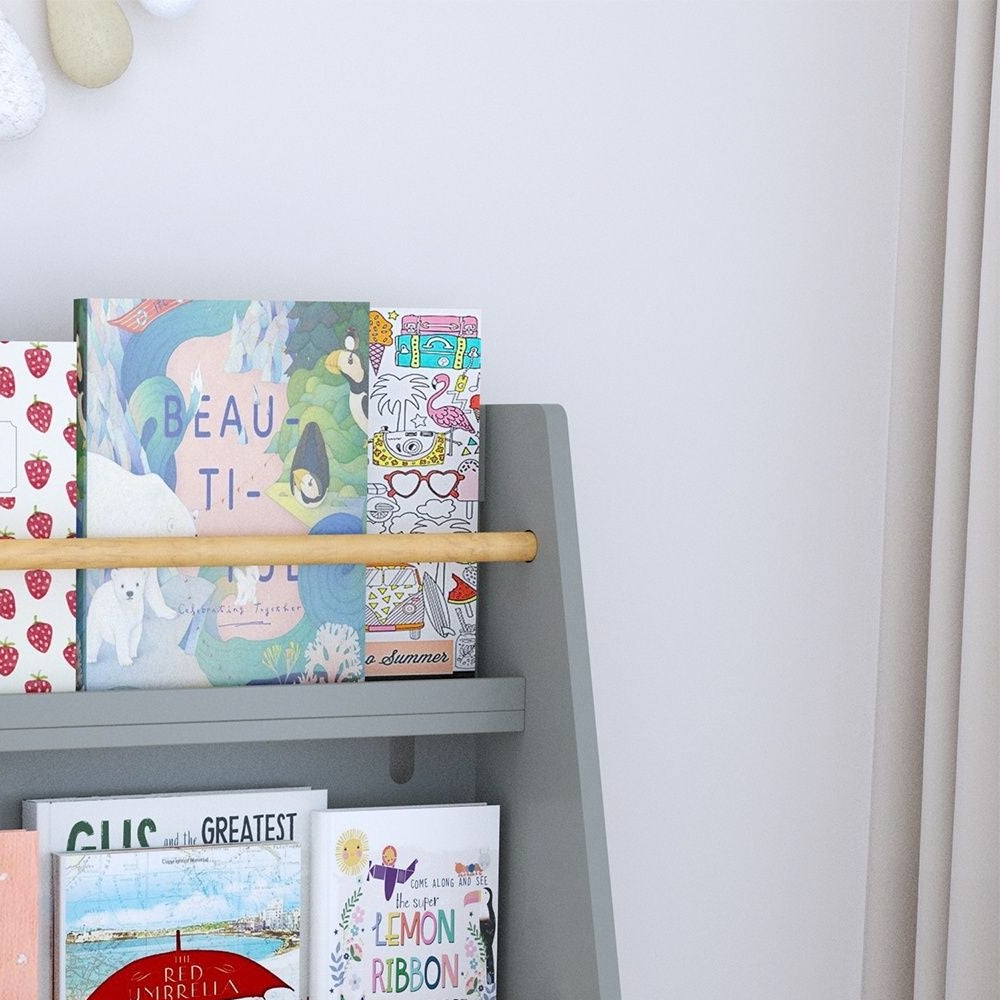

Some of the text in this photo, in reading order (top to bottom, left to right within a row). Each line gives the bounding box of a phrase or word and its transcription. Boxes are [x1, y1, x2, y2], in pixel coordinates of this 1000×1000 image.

[198, 467, 261, 511] TI-
[178, 602, 302, 617] Celebrating Together
[378, 649, 449, 666] Summer
[163, 832, 179, 847] and
[183, 830, 197, 846] the
[201, 812, 298, 845] GREATEST
[410, 875, 489, 889] COME ALONG AND SEE
[395, 892, 440, 911] the super
[371, 908, 455, 947] LEMON
[164, 964, 203, 983] RED
[371, 953, 459, 994] RIBBON
